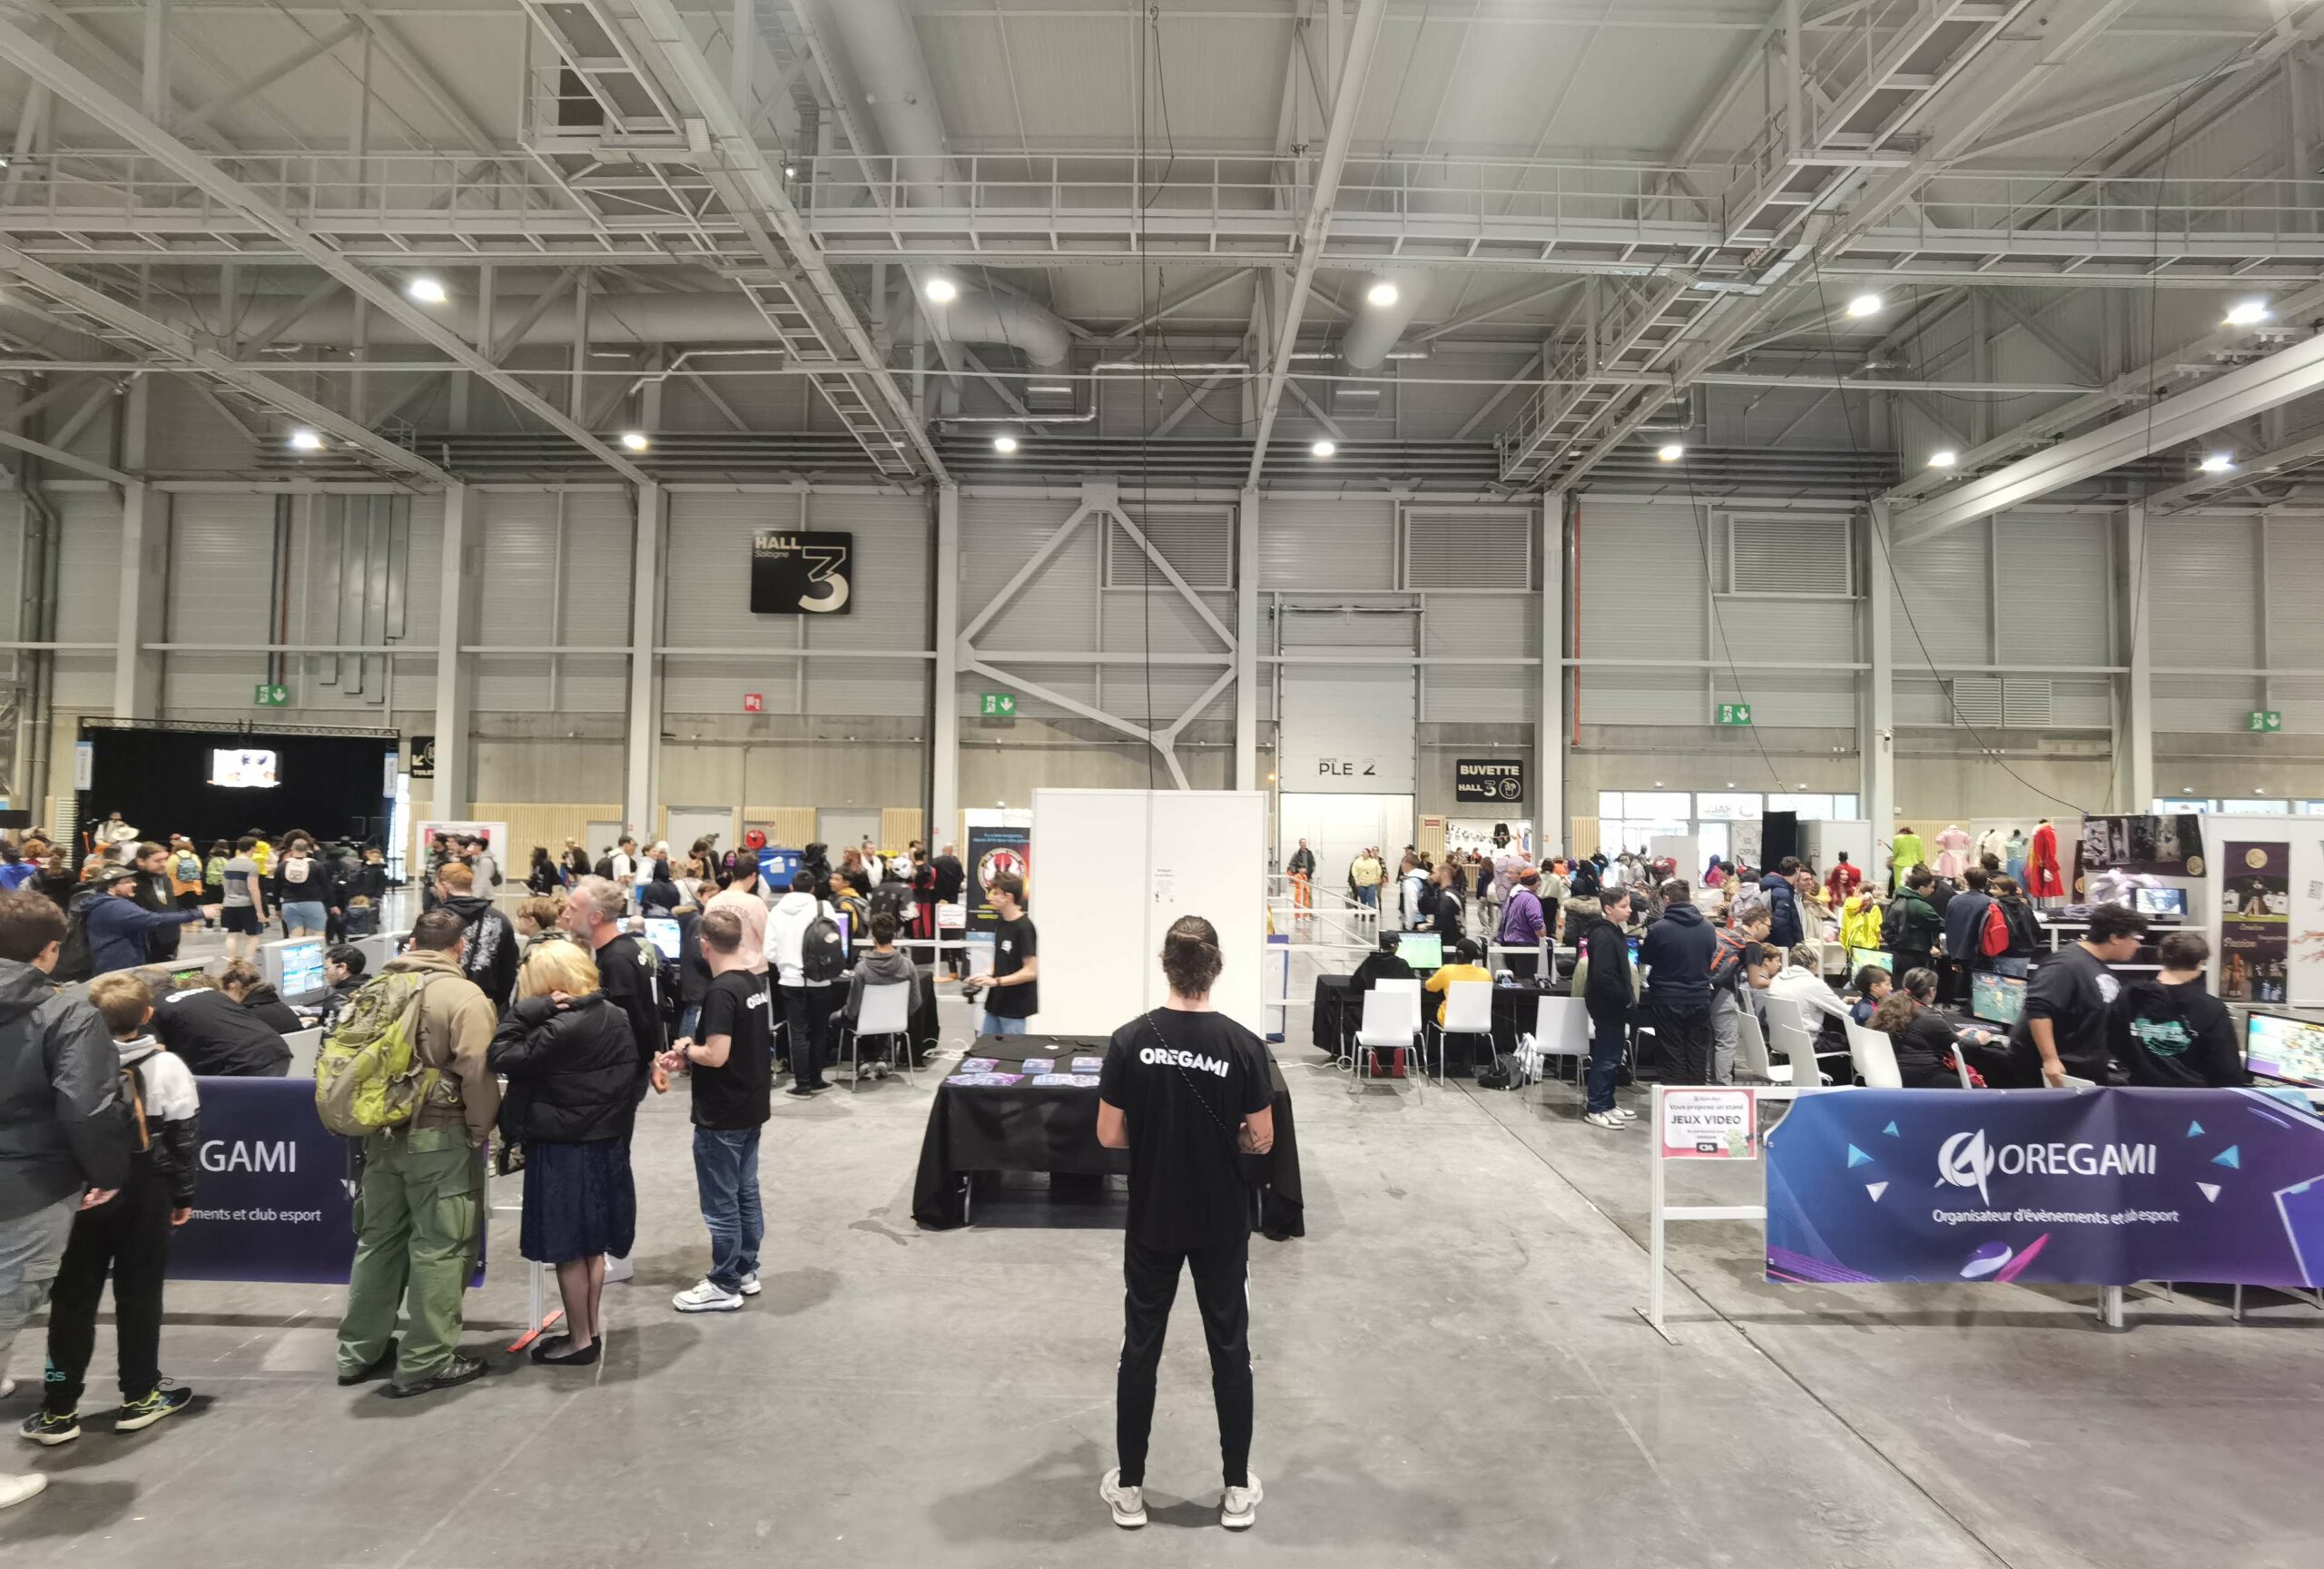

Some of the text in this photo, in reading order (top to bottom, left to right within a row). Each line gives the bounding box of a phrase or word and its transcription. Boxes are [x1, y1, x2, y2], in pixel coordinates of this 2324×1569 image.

[754, 550, 790, 559] Sologne
[754, 537, 850, 613] HALL 3
[1319, 757, 1375, 775] PLE 2
[1460, 765, 1520, 775] BUVETTE
[1483, 779, 1497, 796] 3
[1139, 1048, 1229, 1078] OREGAMI
[1670, 1115, 1742, 1125] JEUX VIDEO
[199, 1140, 296, 1173] GAMI
[1998, 1143, 2156, 1176] OREGAMI
[232, 1209, 246, 1220] et
[249, 1208, 277, 1221] club
[280, 1209, 322, 1224] esport
[1932, 1209, 2012, 1226] Organisateur
[2110, 1212, 2124, 1225] et
[2138, 1210, 2179, 1224] esport
